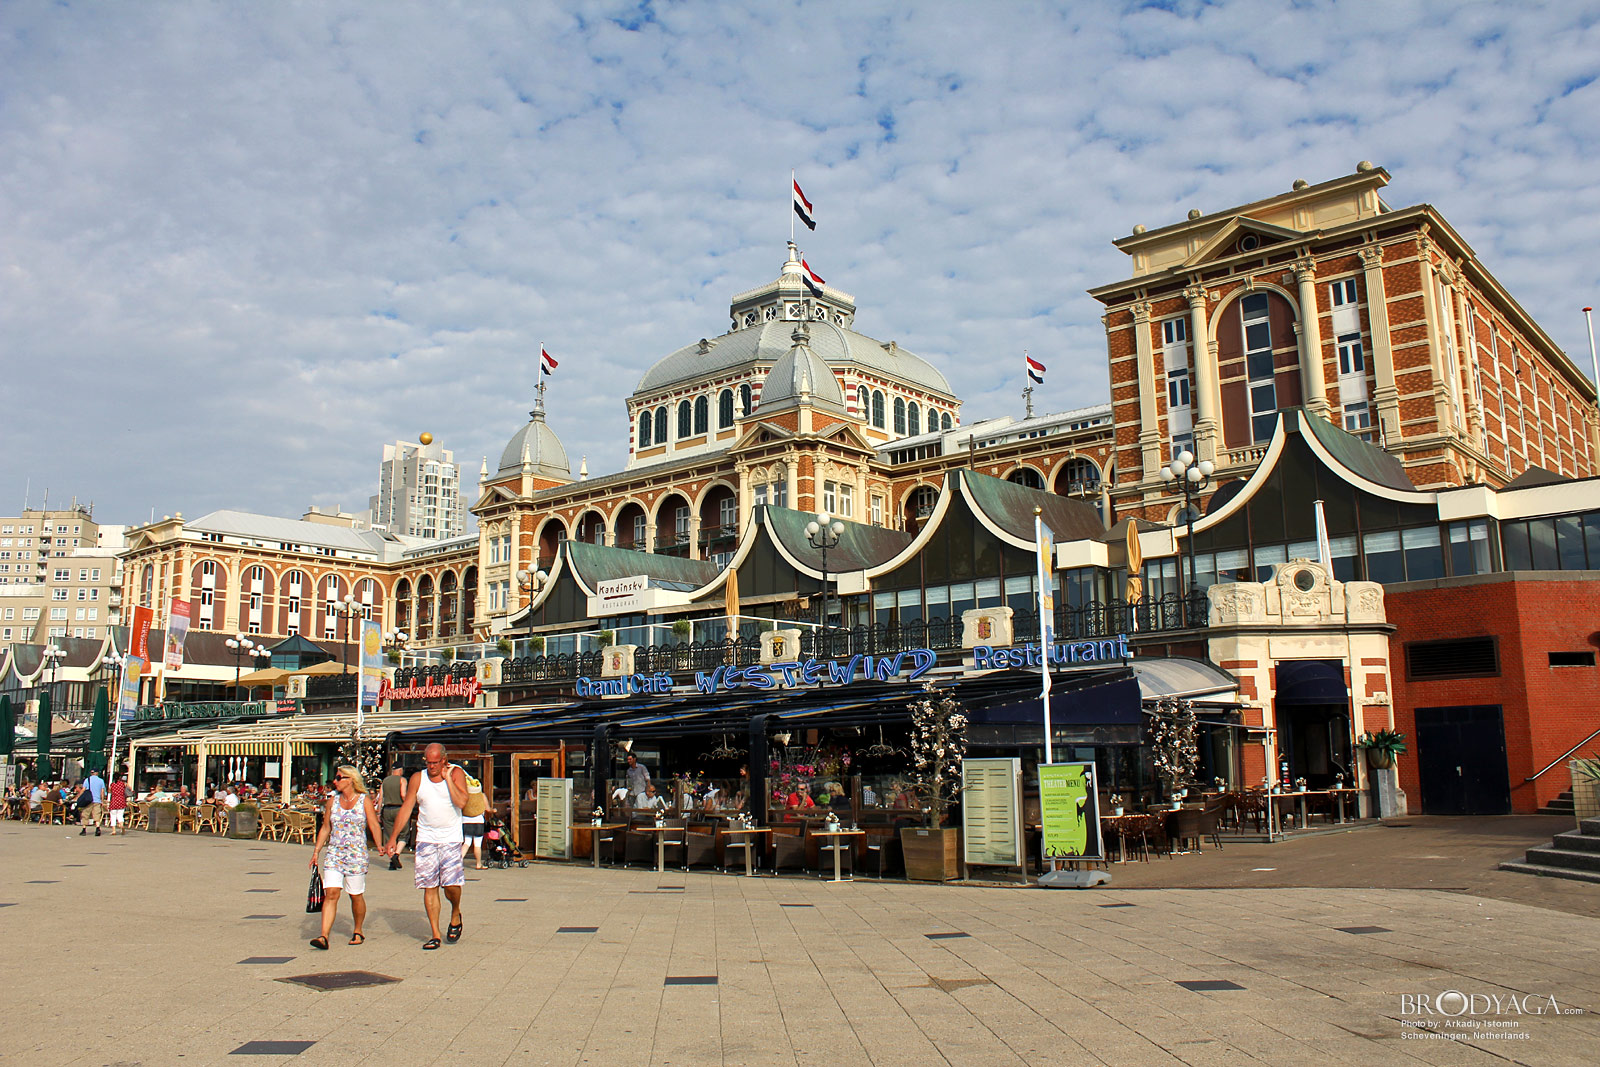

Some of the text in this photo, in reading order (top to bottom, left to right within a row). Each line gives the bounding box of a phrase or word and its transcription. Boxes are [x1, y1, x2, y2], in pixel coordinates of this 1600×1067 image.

[599, 582, 643, 594] Kandinsky
[602, 600, 639, 609] RESTAURANT
[576, 671, 674, 696] Grand Café
